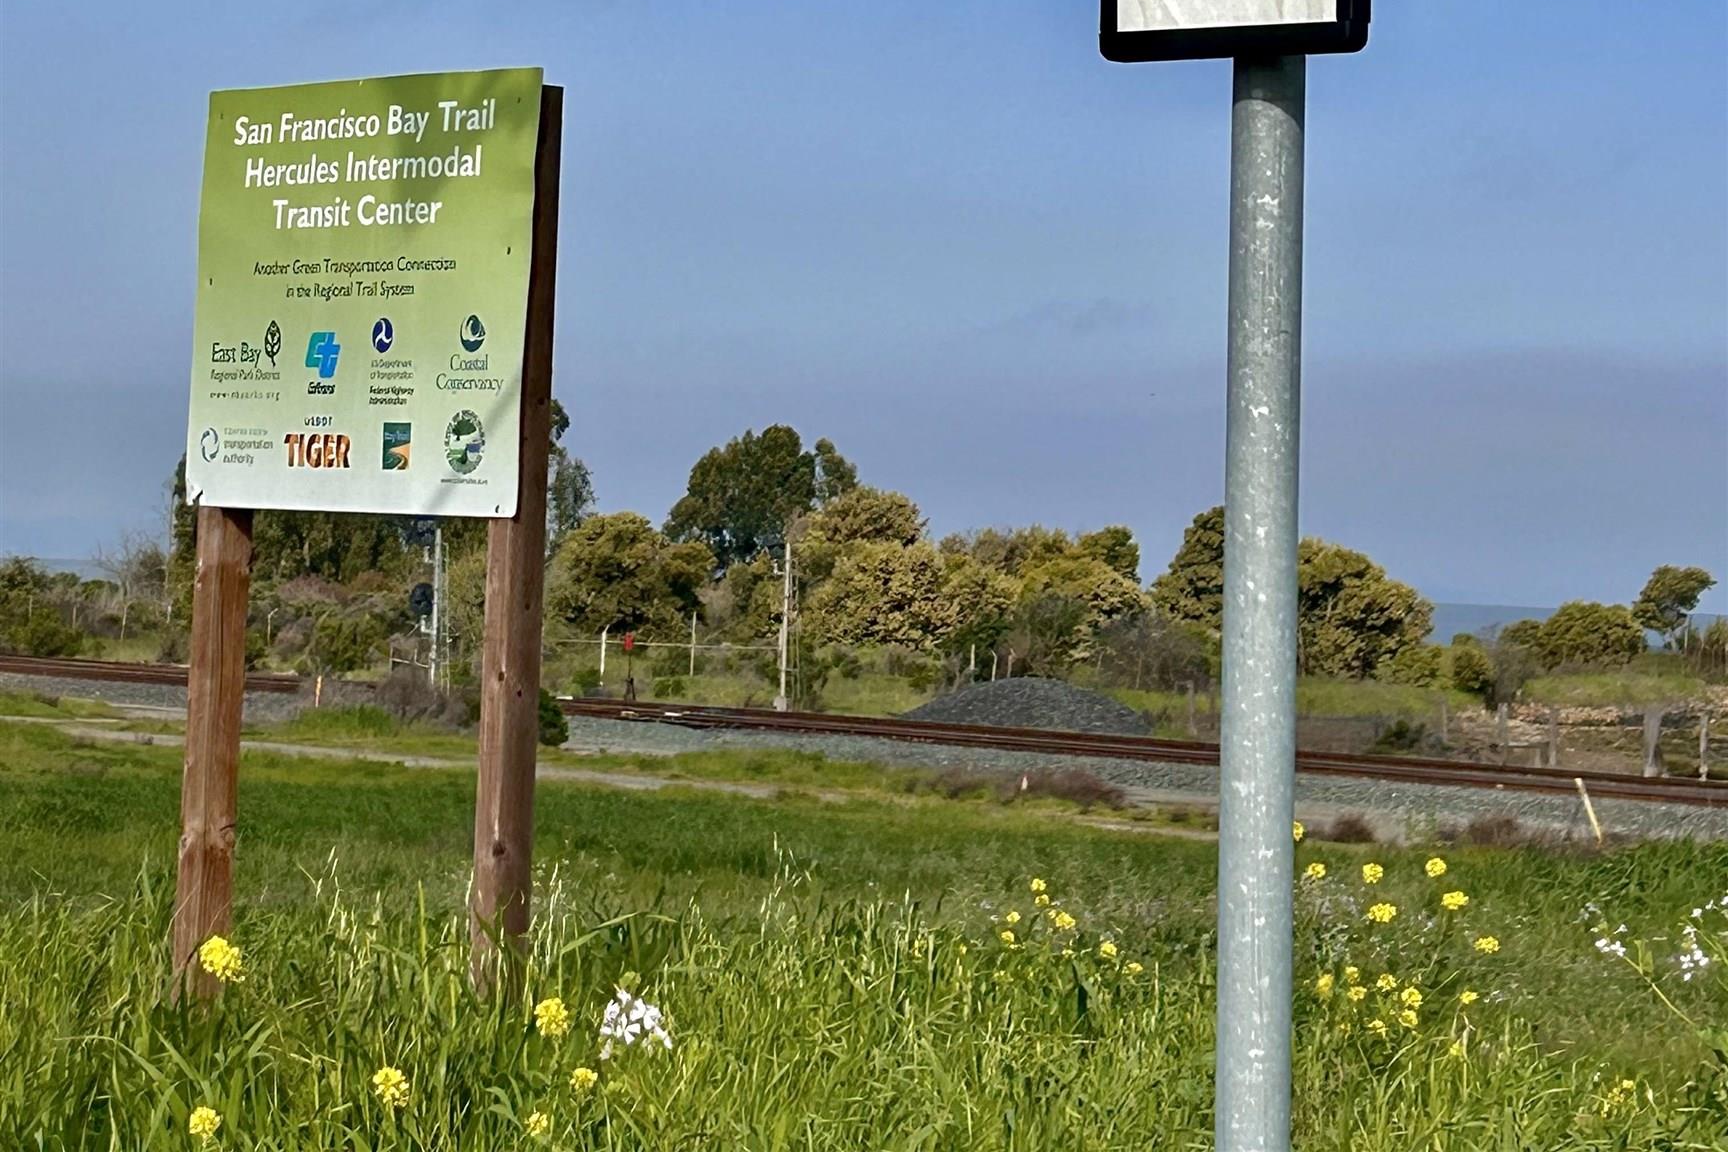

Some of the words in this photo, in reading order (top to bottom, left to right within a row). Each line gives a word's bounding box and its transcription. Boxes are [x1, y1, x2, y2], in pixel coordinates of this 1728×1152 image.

[233, 115, 273, 146] San
[278, 107, 380, 144] Francisco
[387, 104, 430, 145] Bay
[438, 98, 497, 133] Trail
[244, 154, 339, 189] Hercules
[346, 145, 482, 181] Intermodal
[273, 196, 351, 230] Transit
[357, 195, 443, 227] Center
[292, 259, 321, 274] Green
[313, 281, 353, 302] Regional
[355, 280, 378, 297] Trail
[211, 342, 236, 363] East
[240, 342, 262, 368] Bay
[450, 354, 488, 371] Coastal
[284, 433, 352, 469] TIGER
